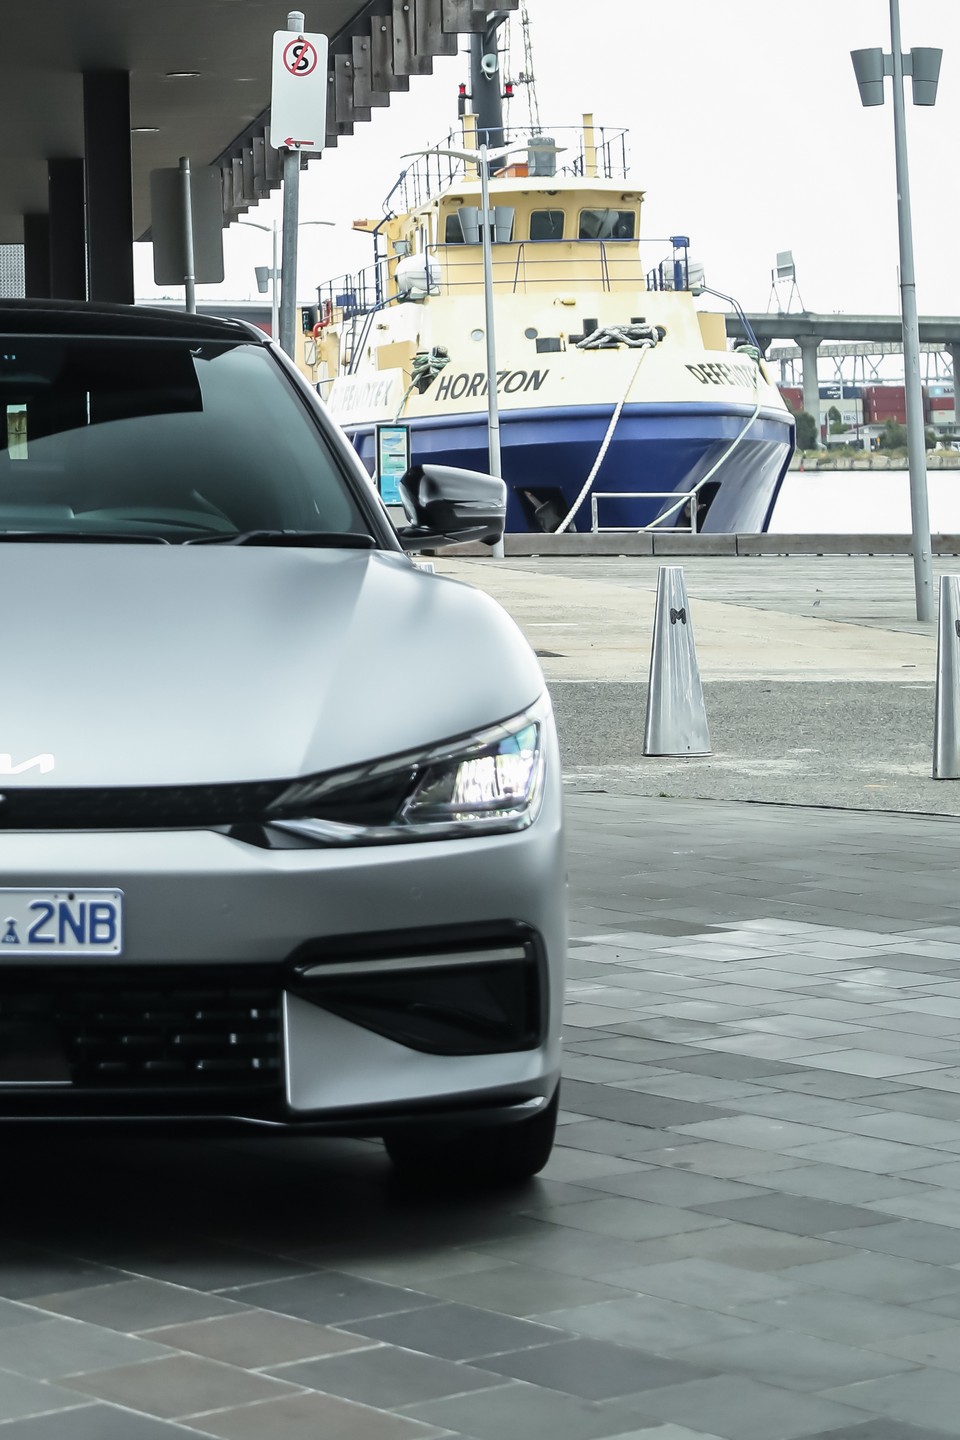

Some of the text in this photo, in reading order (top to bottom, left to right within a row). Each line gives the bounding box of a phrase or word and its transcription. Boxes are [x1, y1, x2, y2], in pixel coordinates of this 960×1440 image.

[292, 45, 309, 70] S
[434, 368, 551, 402] HORIZON
[684, 362, 758, 389] DEFENDT
[331, 379, 394, 413] DFENDTEX
[27, 898, 117, 944] 2NB
